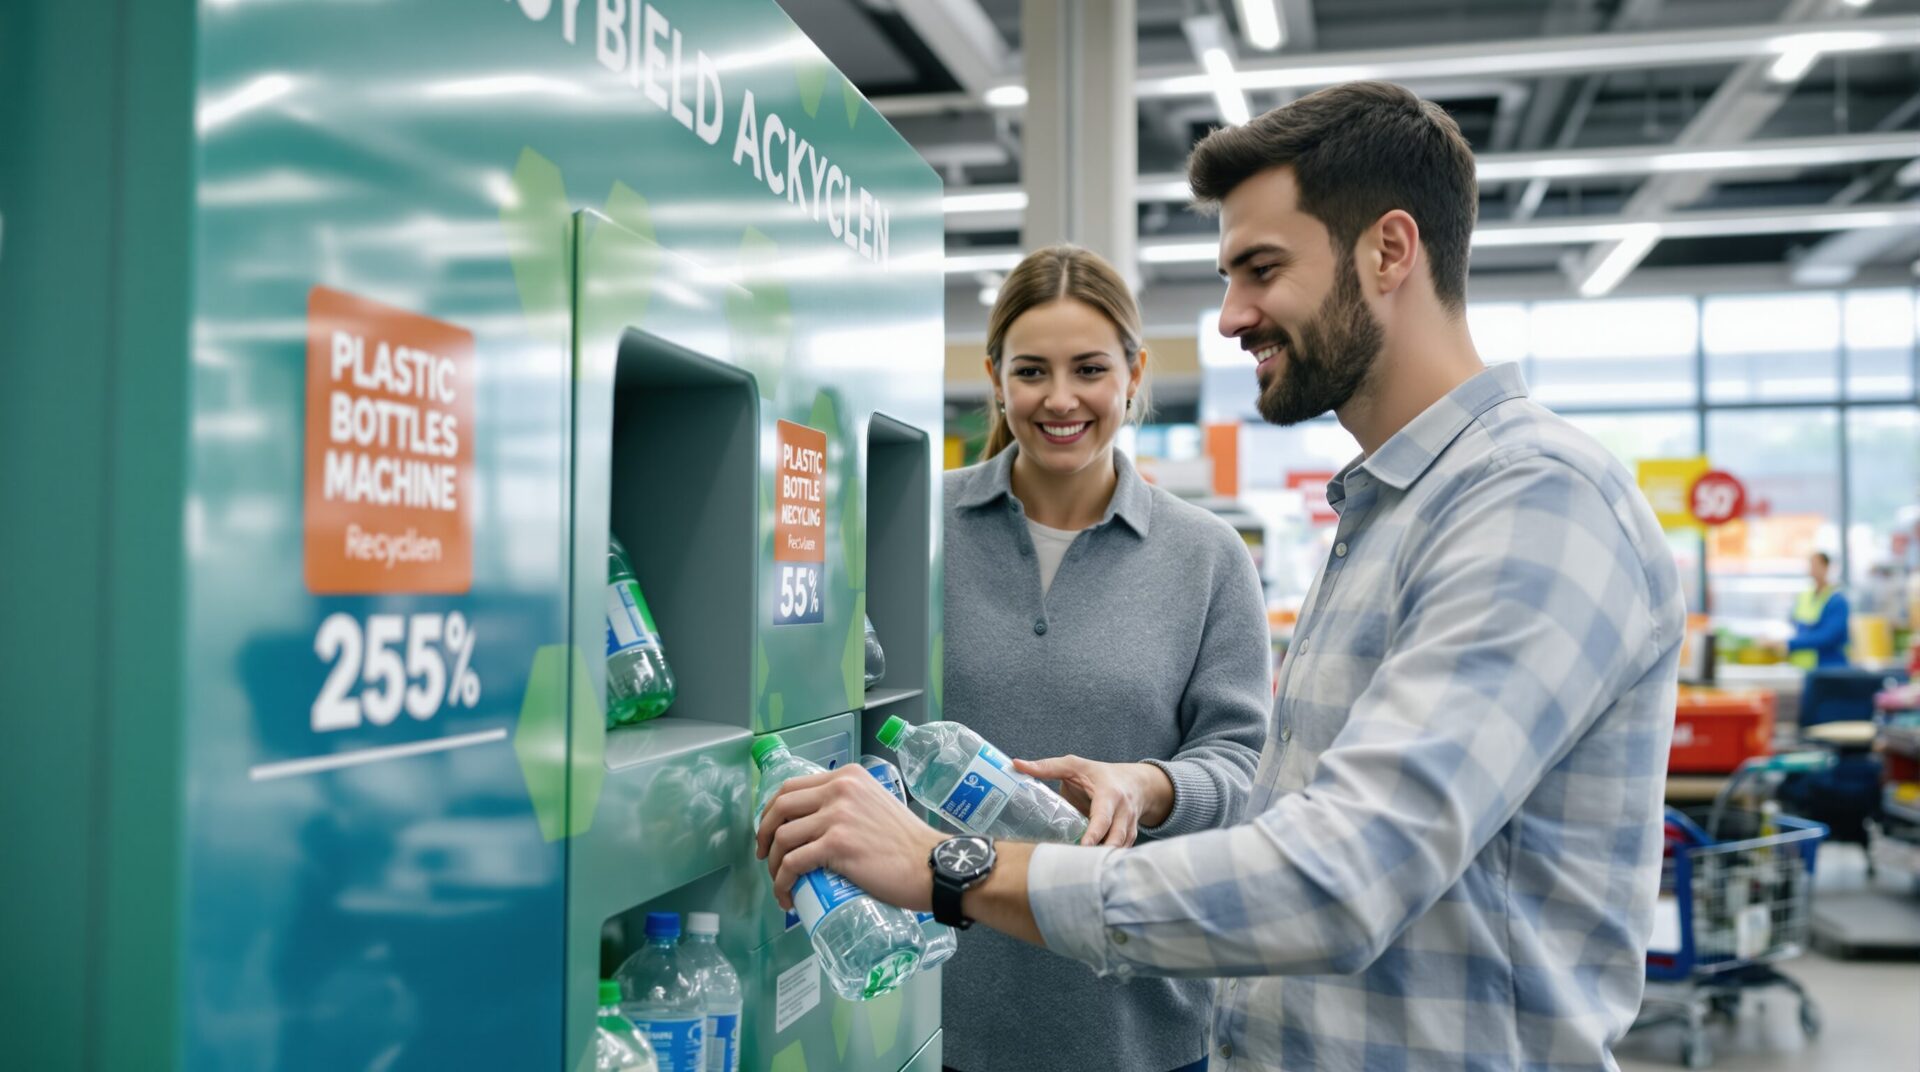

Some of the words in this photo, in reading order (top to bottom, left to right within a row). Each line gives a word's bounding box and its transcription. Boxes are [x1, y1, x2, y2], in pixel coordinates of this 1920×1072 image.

[732, 89, 890, 272] ACKYCLEN
[331, 331, 456, 403] PLASTIC
[330, 392, 458, 457] BOTTLES
[324, 451, 456, 510] MACHINE
[783, 443, 823, 474] PLASTIC
[783, 475, 820, 502] BOTTLE
[780, 566, 819, 618] 55%
[311, 611, 480, 732] 255%
